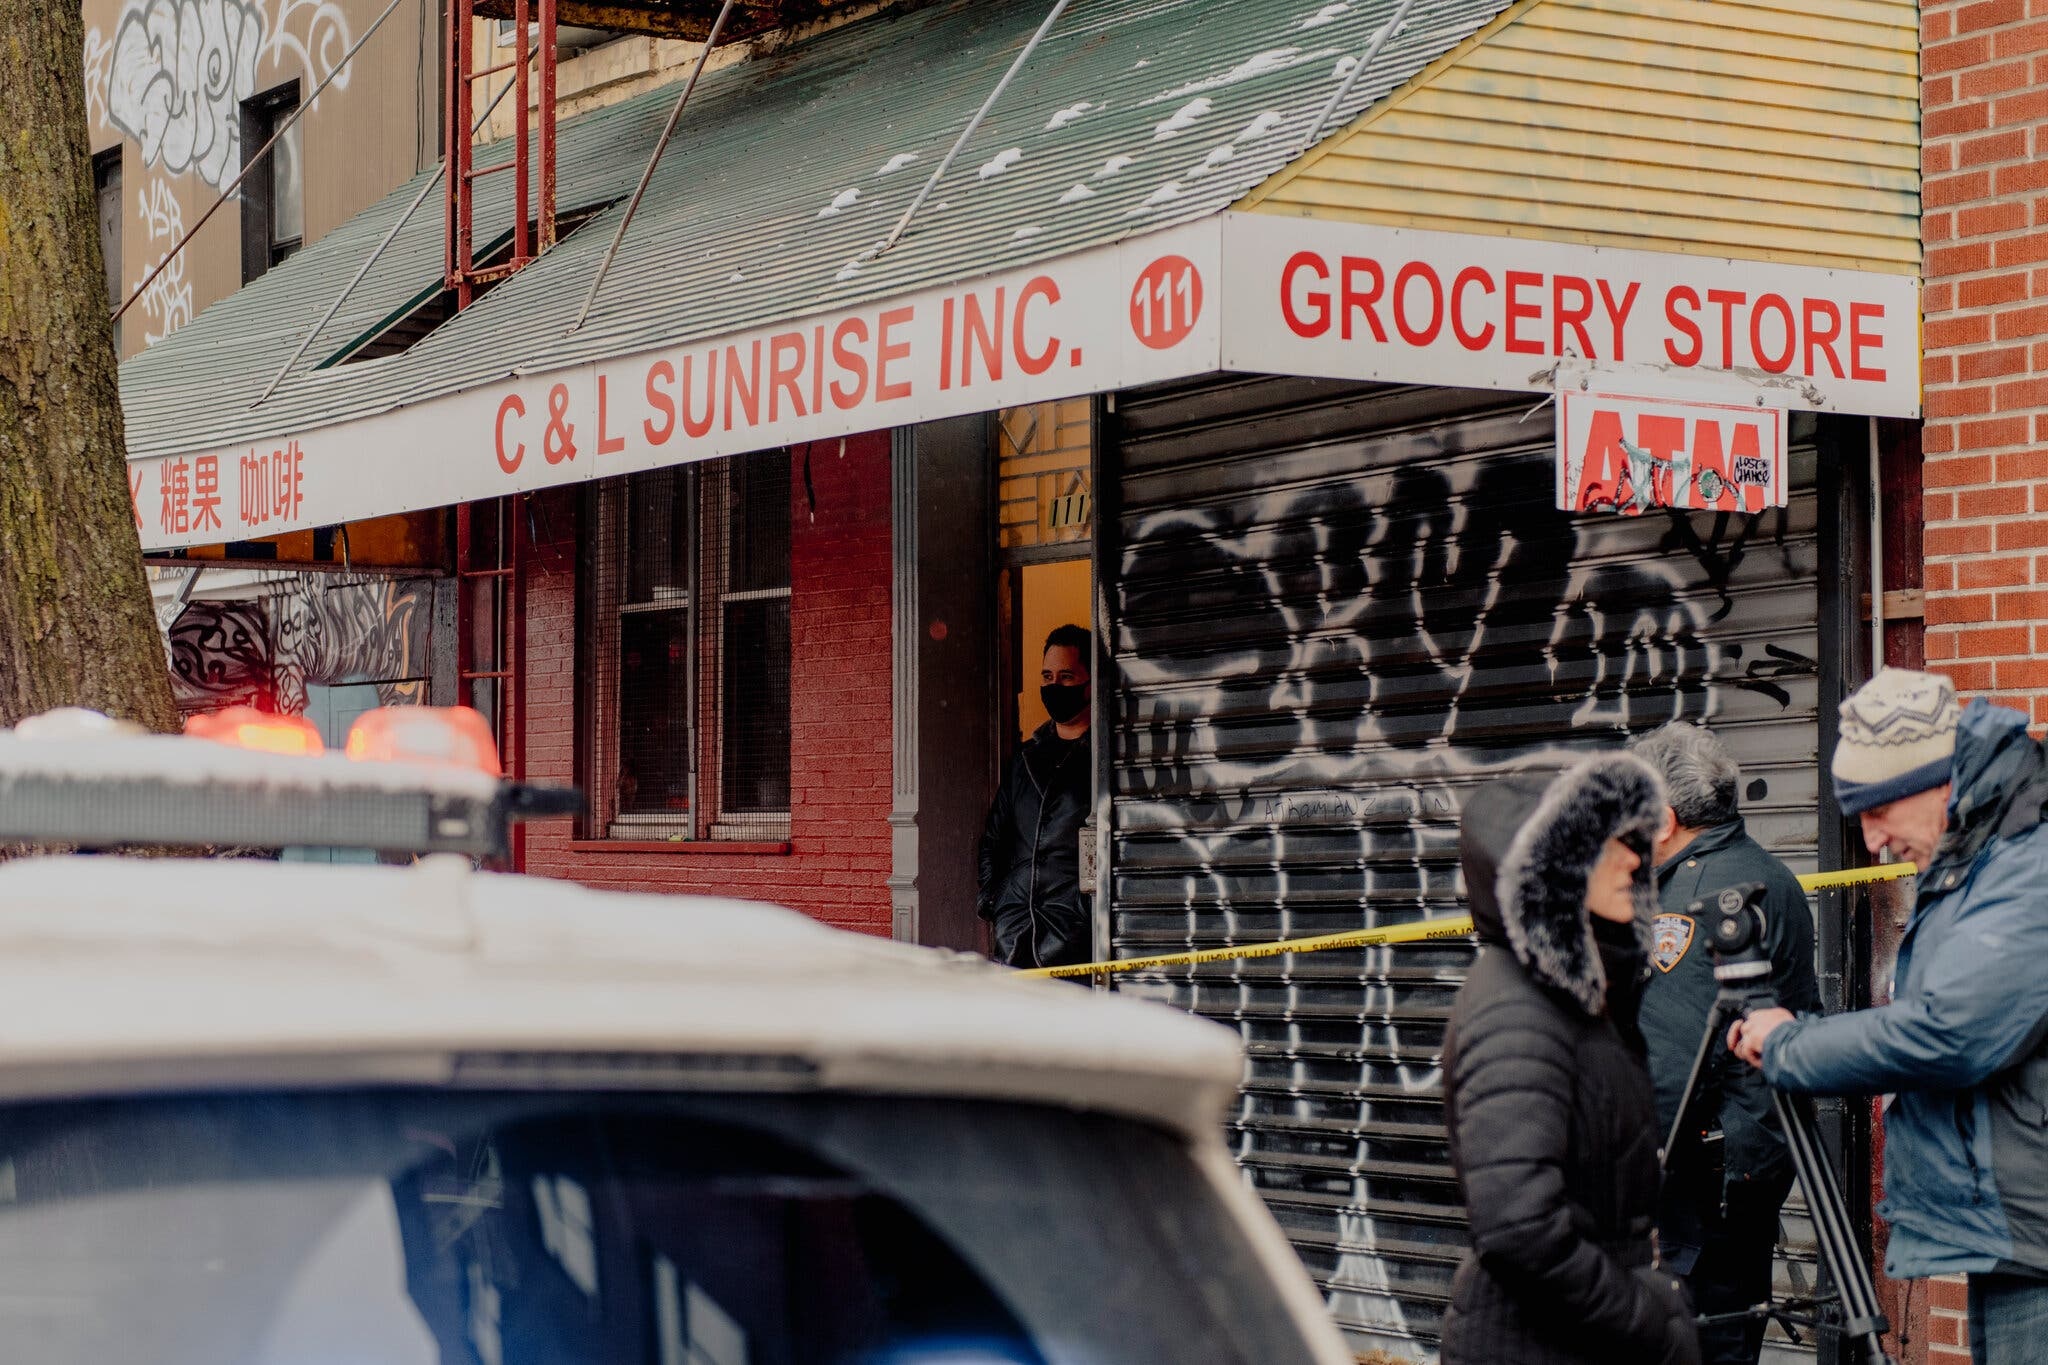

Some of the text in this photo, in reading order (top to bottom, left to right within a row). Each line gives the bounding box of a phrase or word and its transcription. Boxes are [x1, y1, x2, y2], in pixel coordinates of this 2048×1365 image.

[1134, 265, 1193, 338] 111
[1280, 250, 1888, 383] GROCERY STORE
[495, 275, 1082, 475] C & L SUNRISE INC.
[160, 455, 222, 535] 糖果
[240, 440, 304, 527] 咖啡
[1052, 494, 1085, 527] 111
[1575, 409, 1766, 514] ATM
